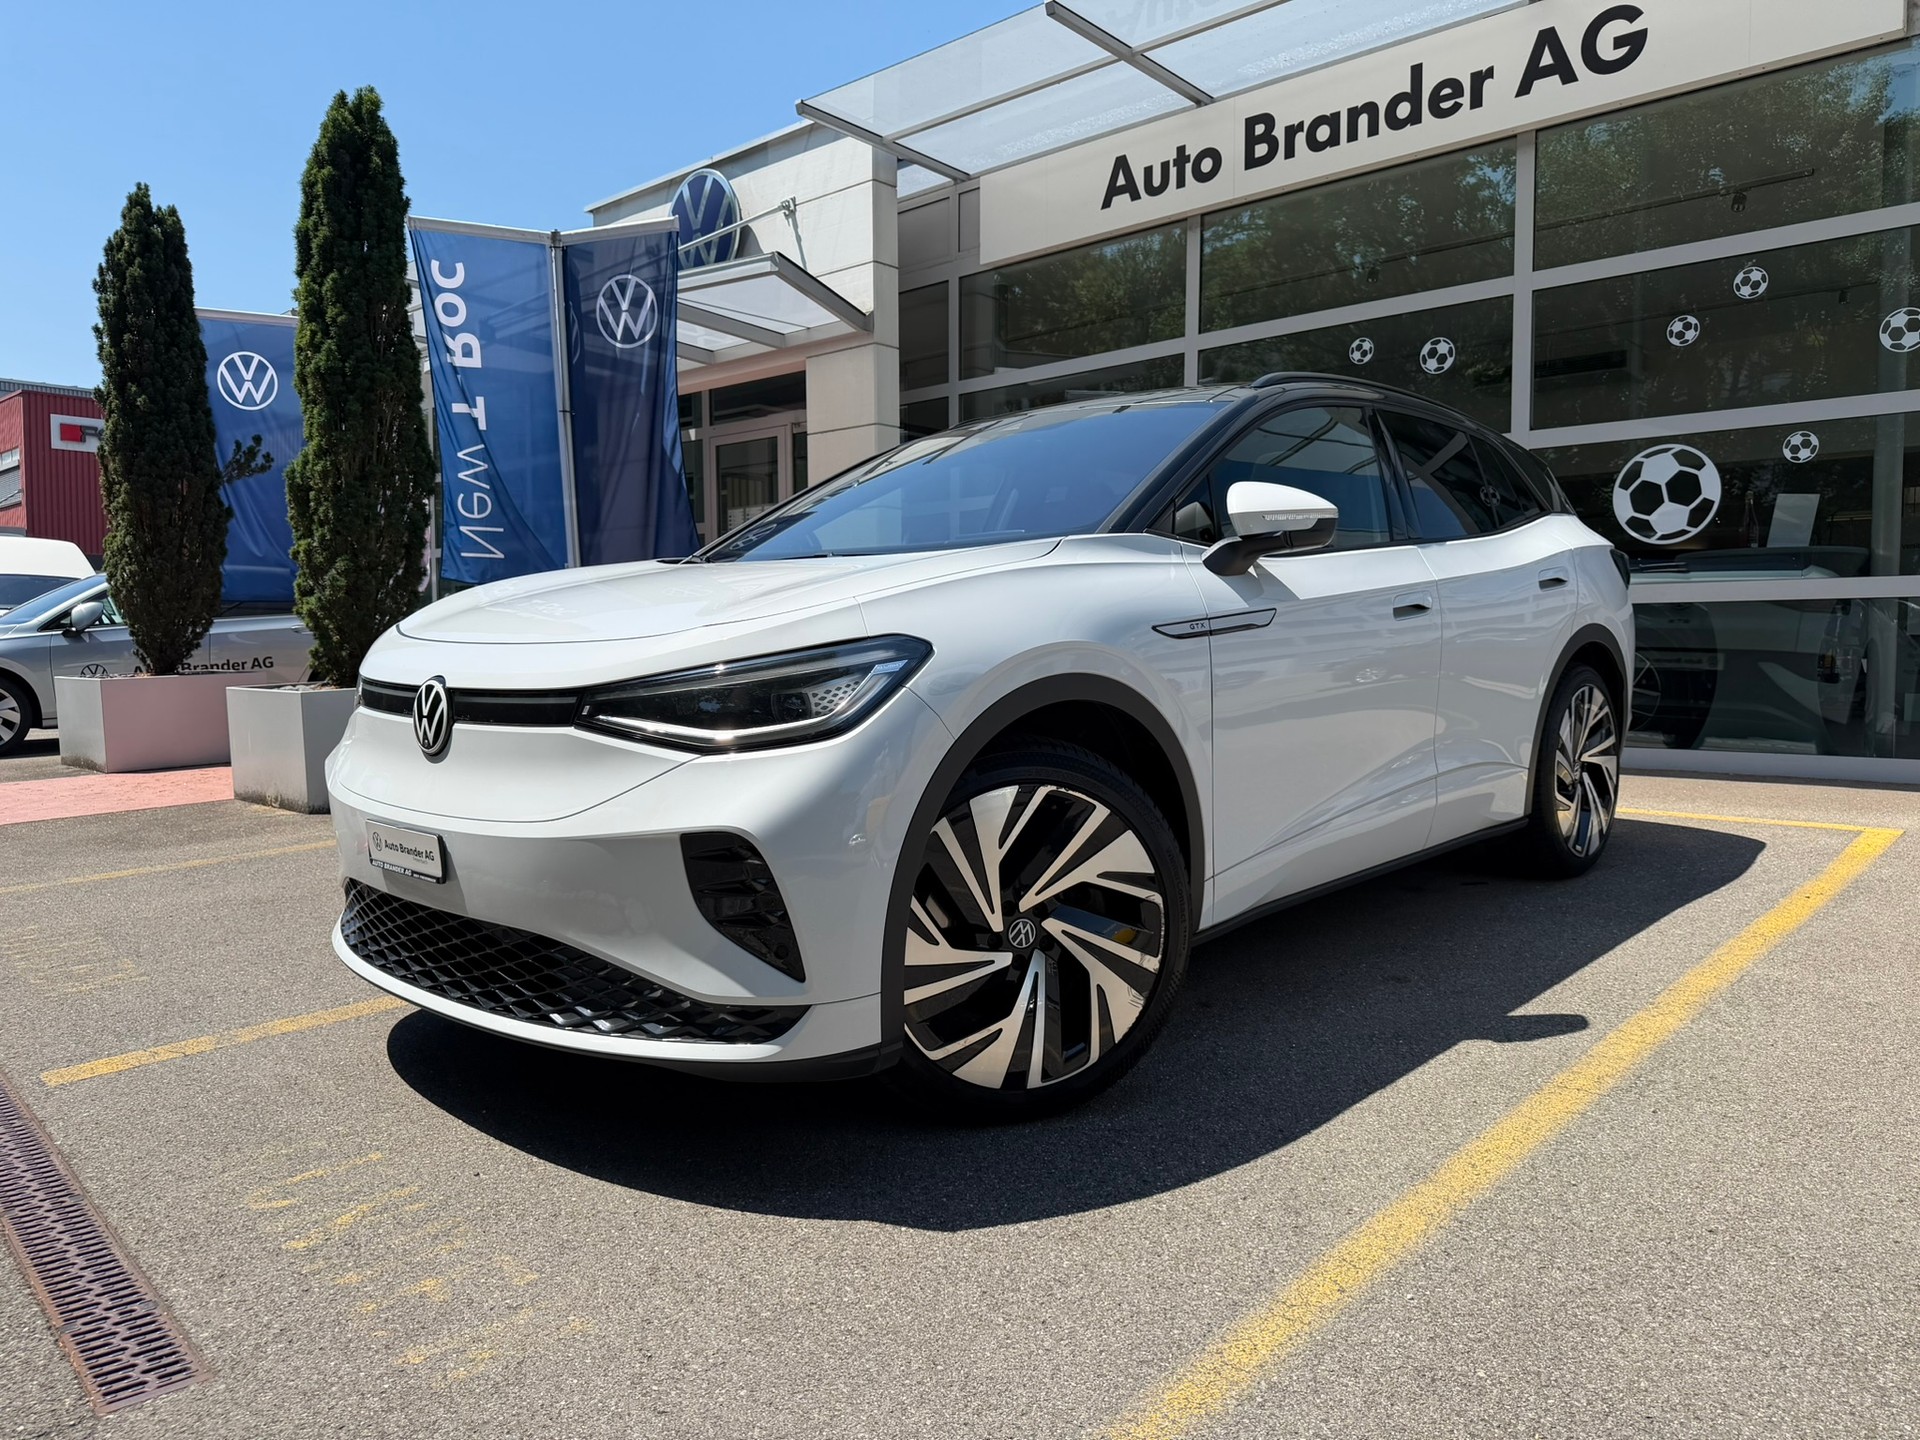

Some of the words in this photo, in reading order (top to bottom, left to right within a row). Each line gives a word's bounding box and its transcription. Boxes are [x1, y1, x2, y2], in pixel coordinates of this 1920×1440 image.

[1100, 144, 1223, 211] Auto
[1244, 62, 1494, 171] Brander
[1514, 4, 1649, 99] AG
[1189, 622, 1206, 630] GTX
[180, 658, 247, 671] Brander
[250, 656, 275, 669] AG
[384, 839, 399, 852] Auto
[399, 843, 424, 859] Brander
[425, 850, 435, 861] AG
[372, 860, 384, 868] AUTO
[384, 862, 405, 874] BRANDER
